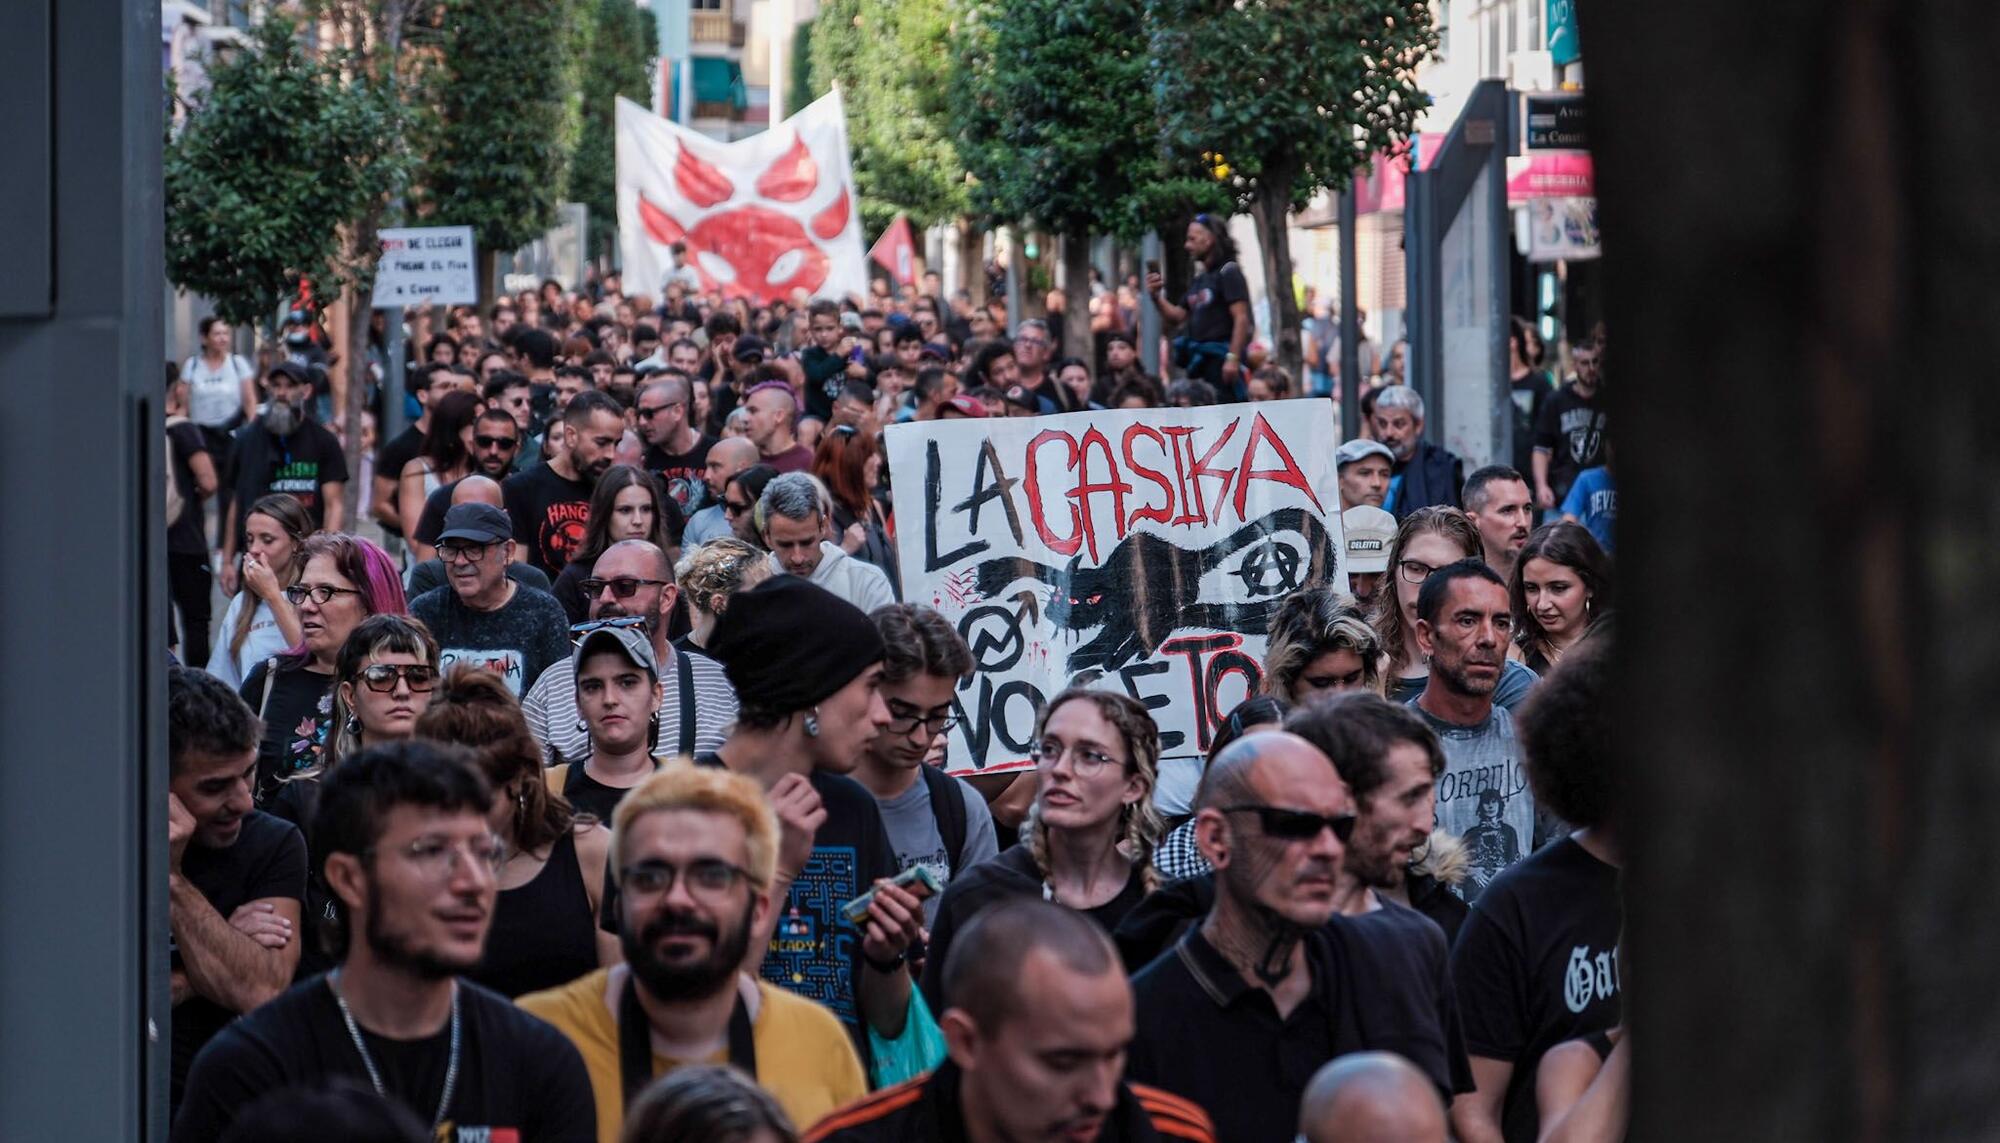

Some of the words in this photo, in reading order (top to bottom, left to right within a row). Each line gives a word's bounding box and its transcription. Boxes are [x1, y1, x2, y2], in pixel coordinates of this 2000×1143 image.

[925, 437, 1024, 572] LA
[1023, 411, 1326, 566] CASIKA
[1160, 632, 1266, 752] TO
